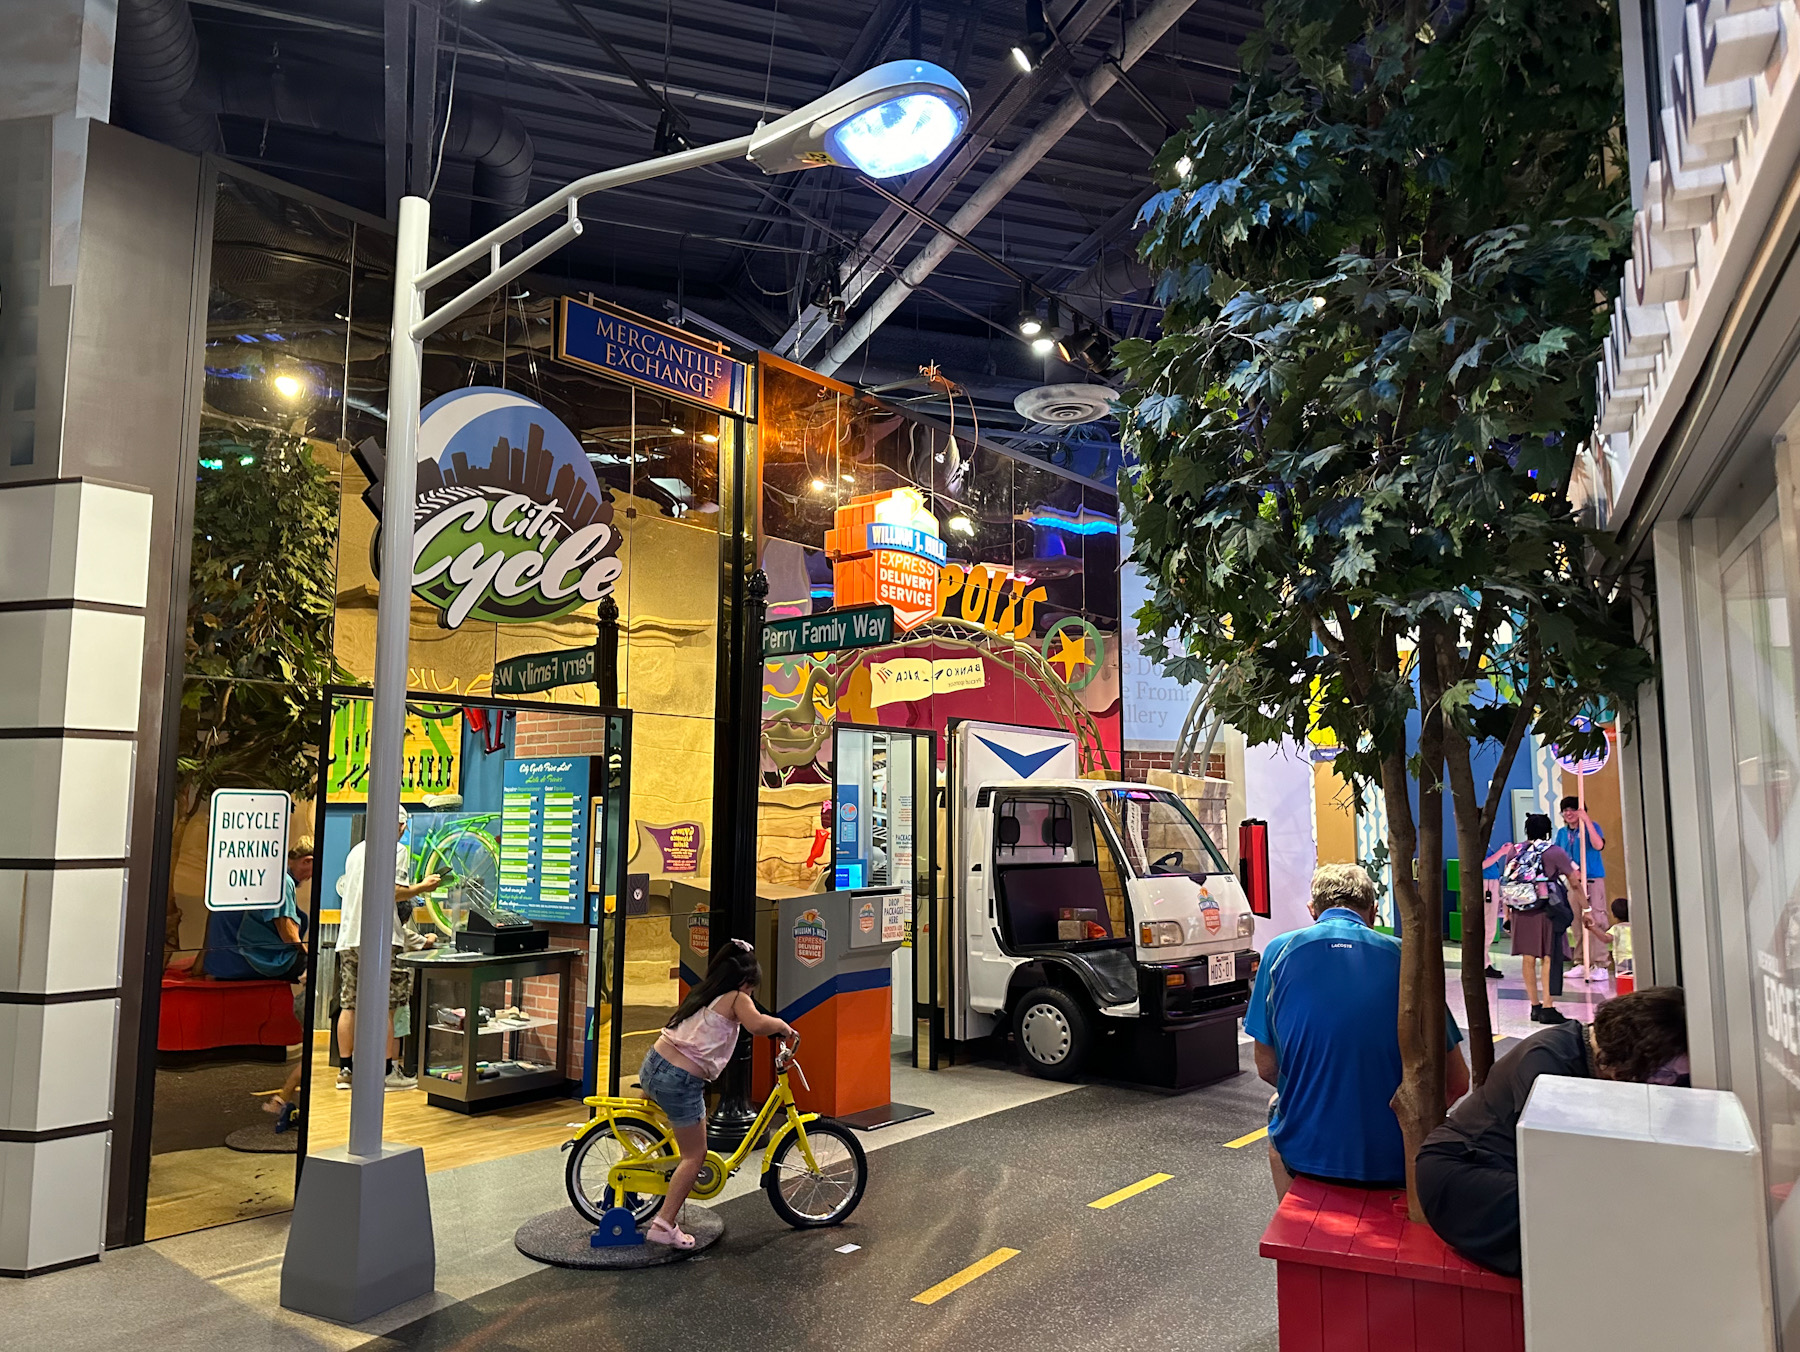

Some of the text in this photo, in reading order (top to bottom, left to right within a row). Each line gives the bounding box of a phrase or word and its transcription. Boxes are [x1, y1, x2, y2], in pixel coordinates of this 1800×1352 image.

[596, 317, 722, 379] MERCANTILE
[606, 342, 714, 399] EXCHANGE
[491, 494, 564, 553] City
[872, 526, 946, 562] WILLIAM J. HILL
[411, 496, 623, 628] Cycle
[880, 551, 934, 576] EXPRESS
[880, 568, 933, 591] DELIVERY
[880, 584, 932, 607] SERVICE
[762, 613, 886, 652] Perry Family Way
[1136, 681, 1192, 702] From?
[222, 812, 280, 829] BICYCLE
[219, 840, 279, 858] PARKING
[229, 869, 266, 887] ONLY
[884, 906, 903, 915] PACKAGES
[889, 916, 898, 924] HERE
